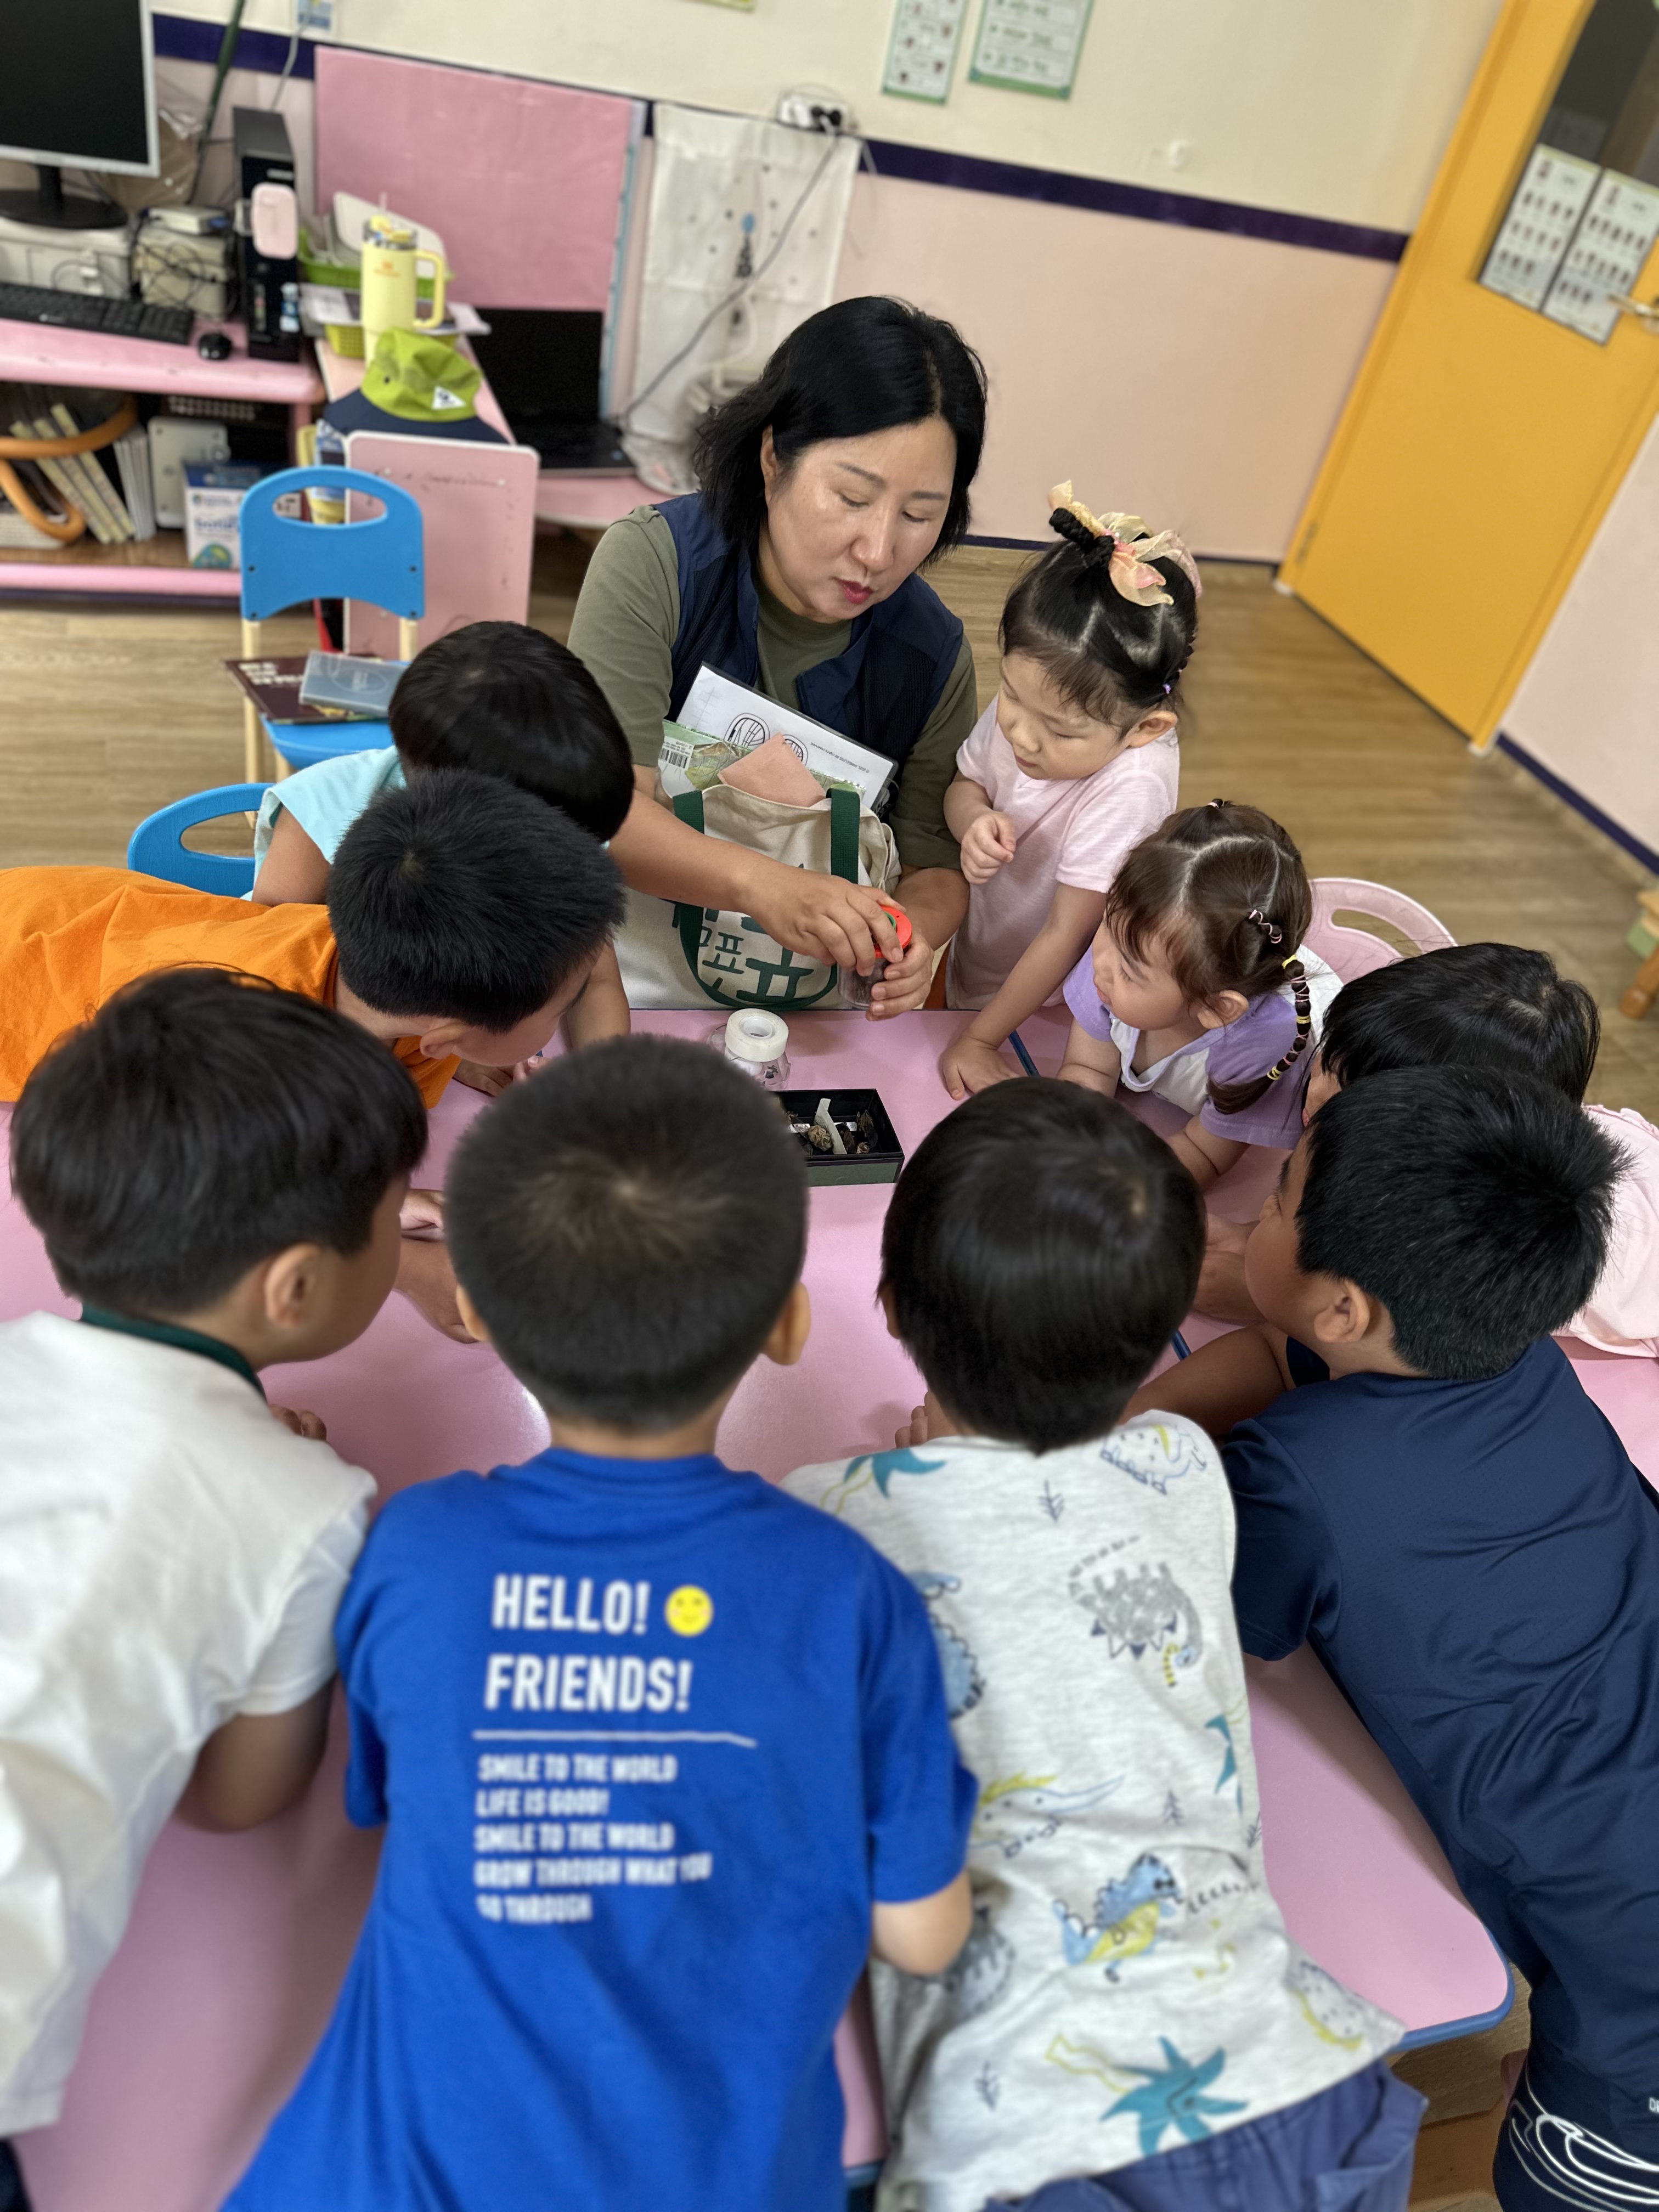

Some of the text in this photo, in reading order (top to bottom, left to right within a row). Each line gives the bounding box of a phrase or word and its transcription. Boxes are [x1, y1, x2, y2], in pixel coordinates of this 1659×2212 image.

[492, 1573, 651, 1635] HELLO!
[484, 1653, 693, 1712] FRIENDS!
[478, 1753, 678, 1782] SMILE TO THE WORLD
[476, 1788, 521, 1817] LIFE
[523, 1788, 548, 1816] IS
[474, 1822, 675, 1852] SMILE TO THE WORLD
